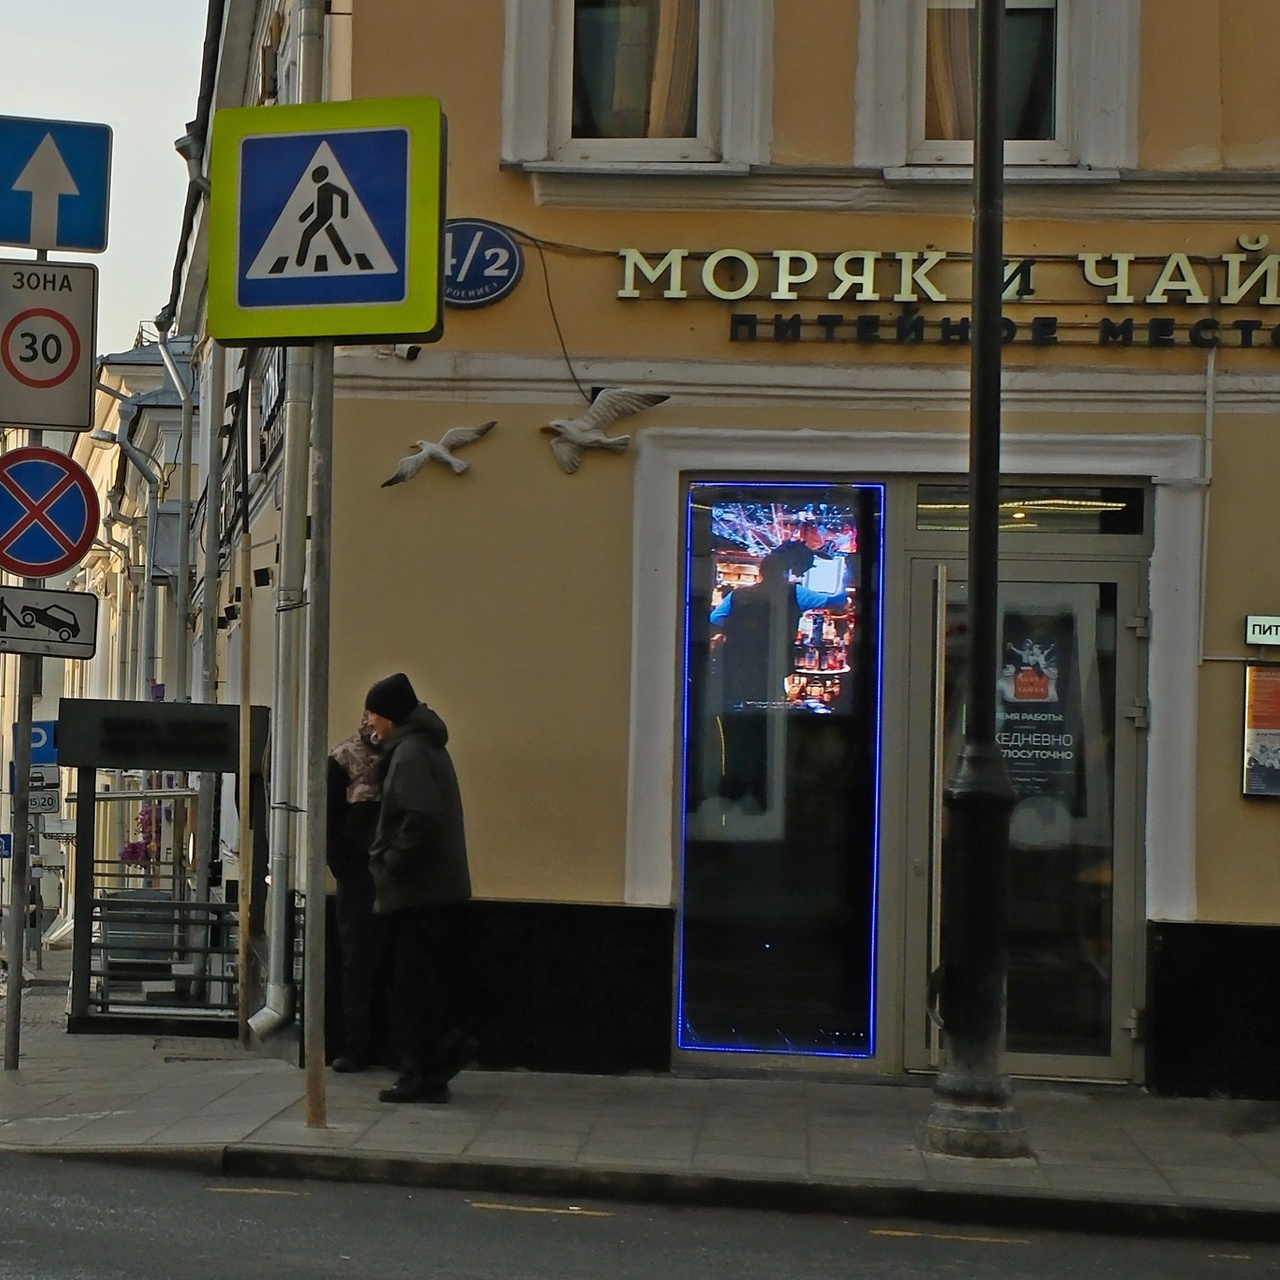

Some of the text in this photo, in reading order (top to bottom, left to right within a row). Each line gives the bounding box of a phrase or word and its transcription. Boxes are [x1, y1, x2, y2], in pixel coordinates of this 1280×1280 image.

[617, 248, 947, 302] МОРЯК
[1077, 234, 1280, 305] ЧАЙ
[12, 271, 73, 293] ЗОНА
[445, 284, 491, 297] РОЕНИЕ
[19, 331, 63, 365] 30
[40, 796, 54, 807] 20
